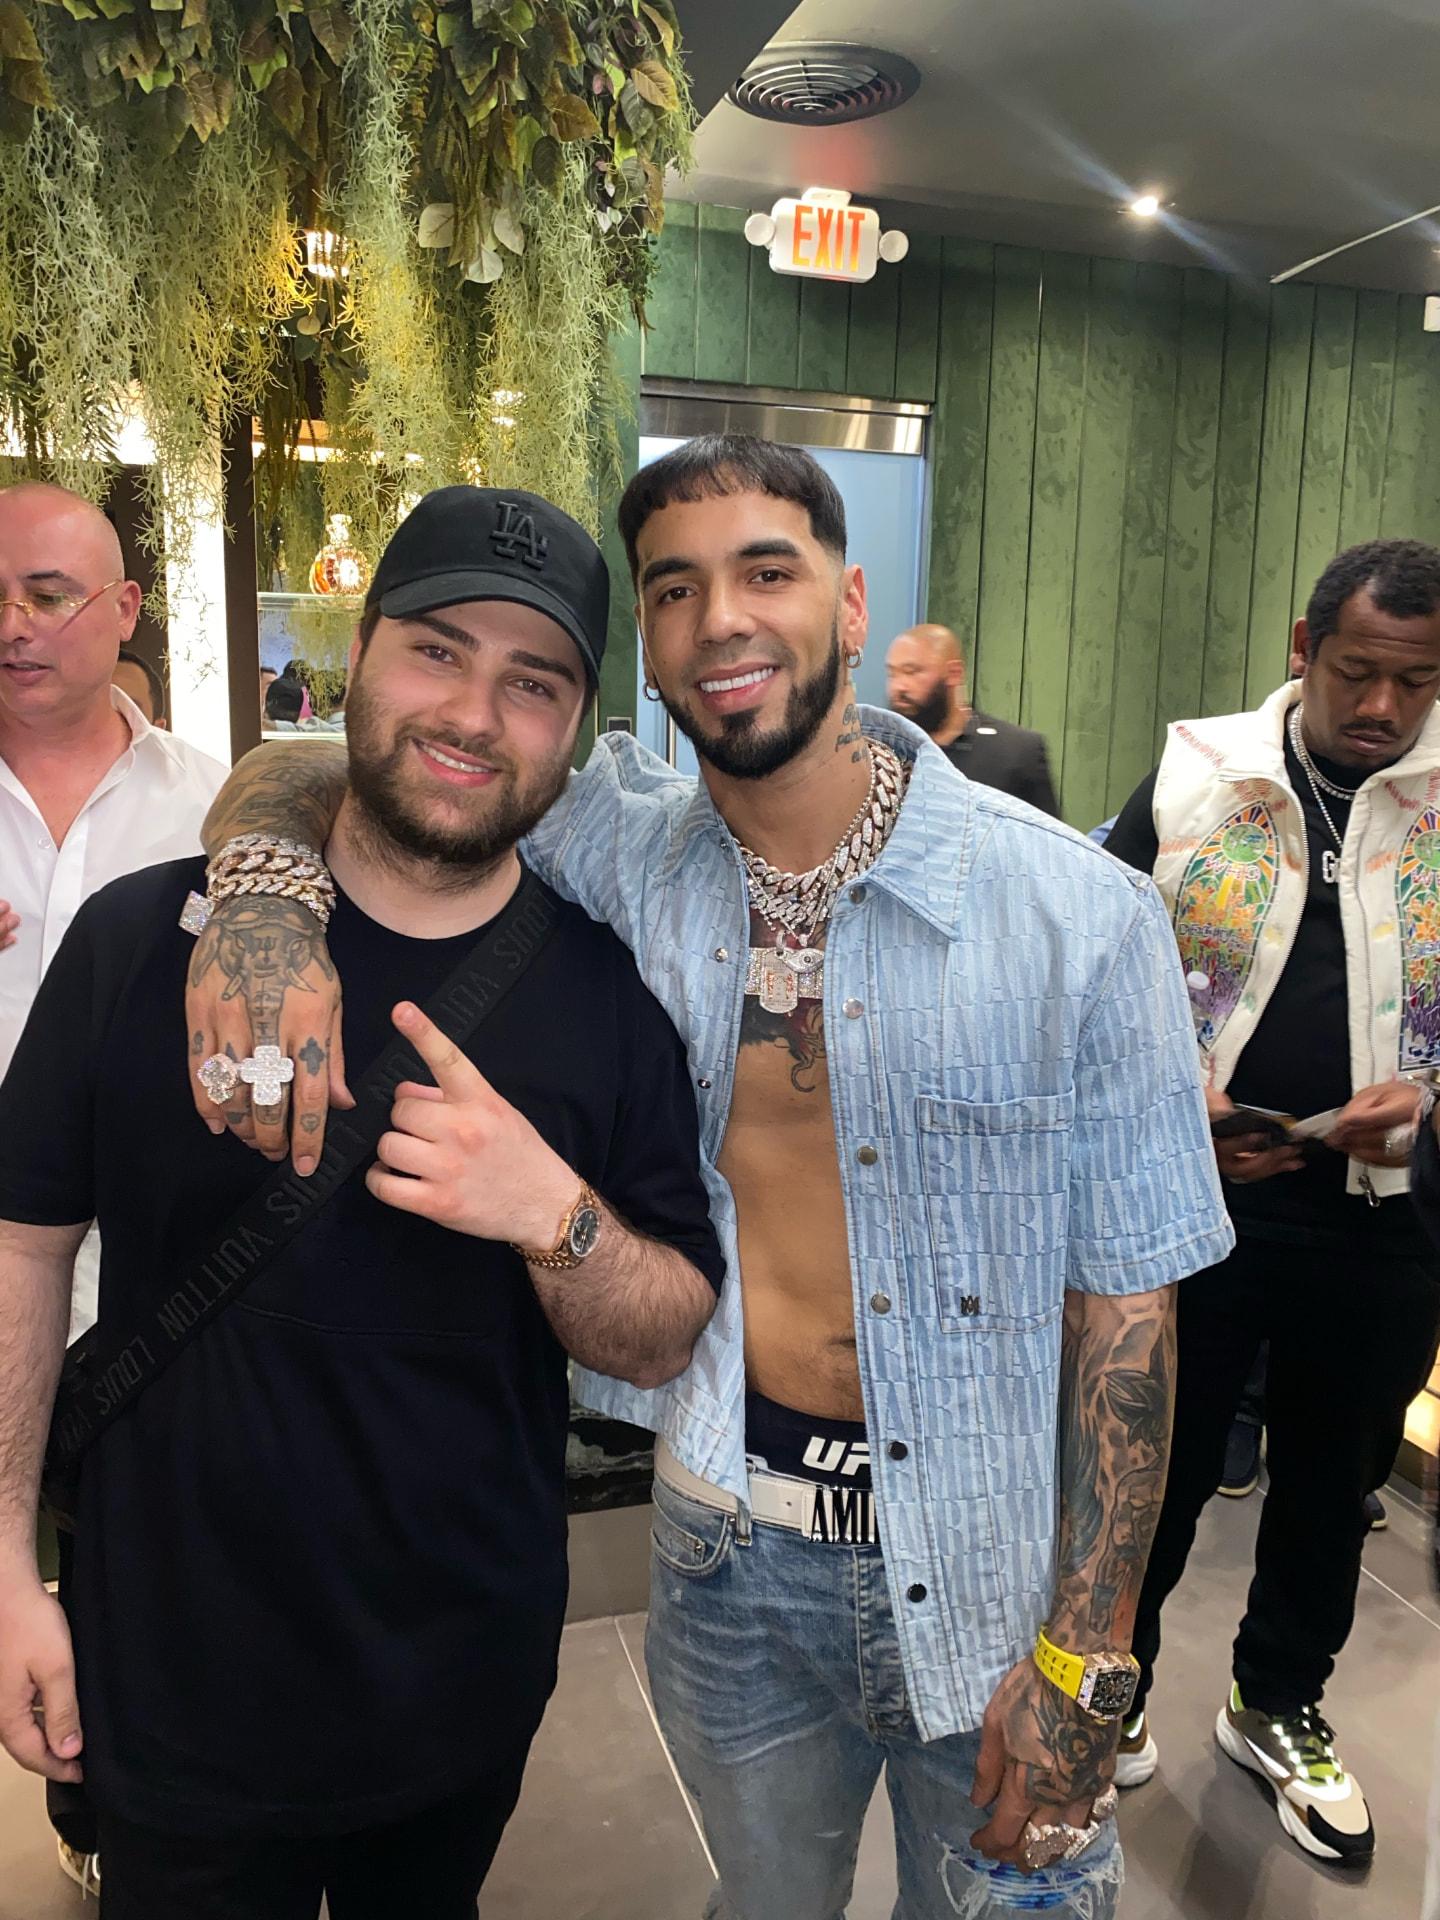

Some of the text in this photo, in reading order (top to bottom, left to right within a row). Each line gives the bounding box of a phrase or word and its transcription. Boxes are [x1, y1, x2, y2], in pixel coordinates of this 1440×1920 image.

[792, 204, 866, 273] EXIT
[490, 501, 548, 571] LA
[1204, 853, 1261, 881] WHO
[493, 888, 558, 970] LOUIS
[156, 1225, 274, 1341] VUITTON
[92, 1335, 156, 1416] LOUIS
[808, 1487, 880, 1543] AMI
